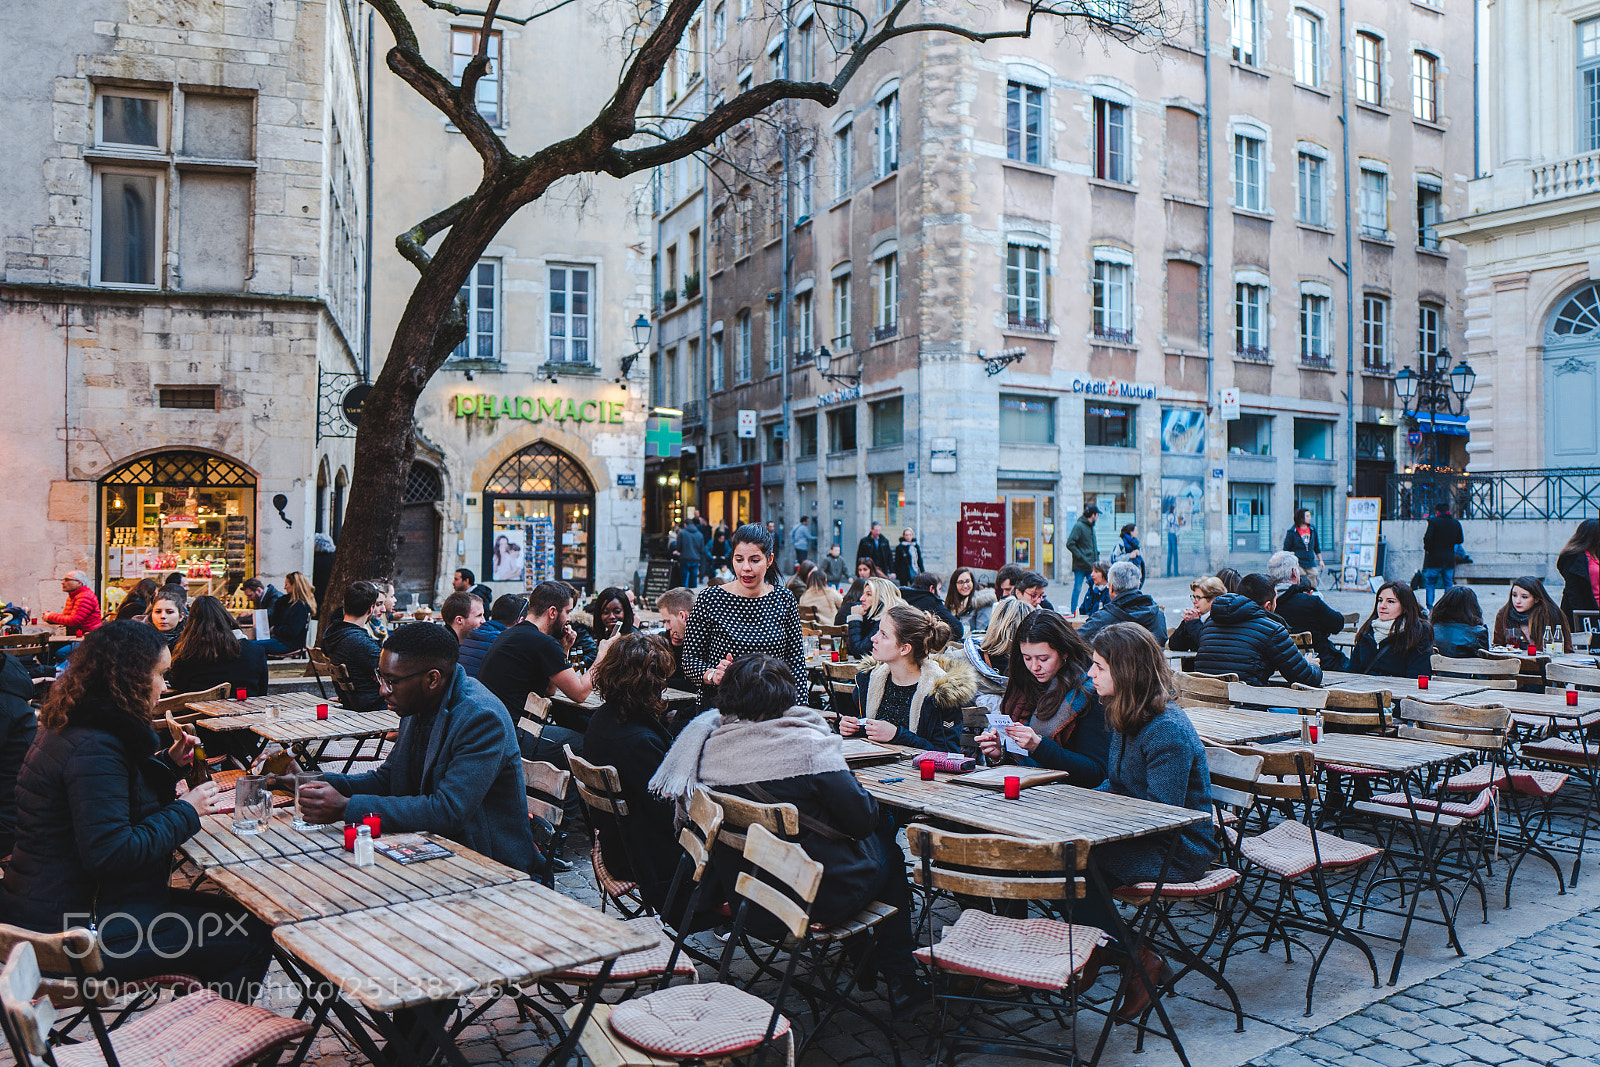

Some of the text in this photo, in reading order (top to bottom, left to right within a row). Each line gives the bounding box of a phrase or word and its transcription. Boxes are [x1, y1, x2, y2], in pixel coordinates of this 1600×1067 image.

[1072, 379, 1157, 400] Crédit Mutuel
[456, 394, 625, 423] PHARMACIE
